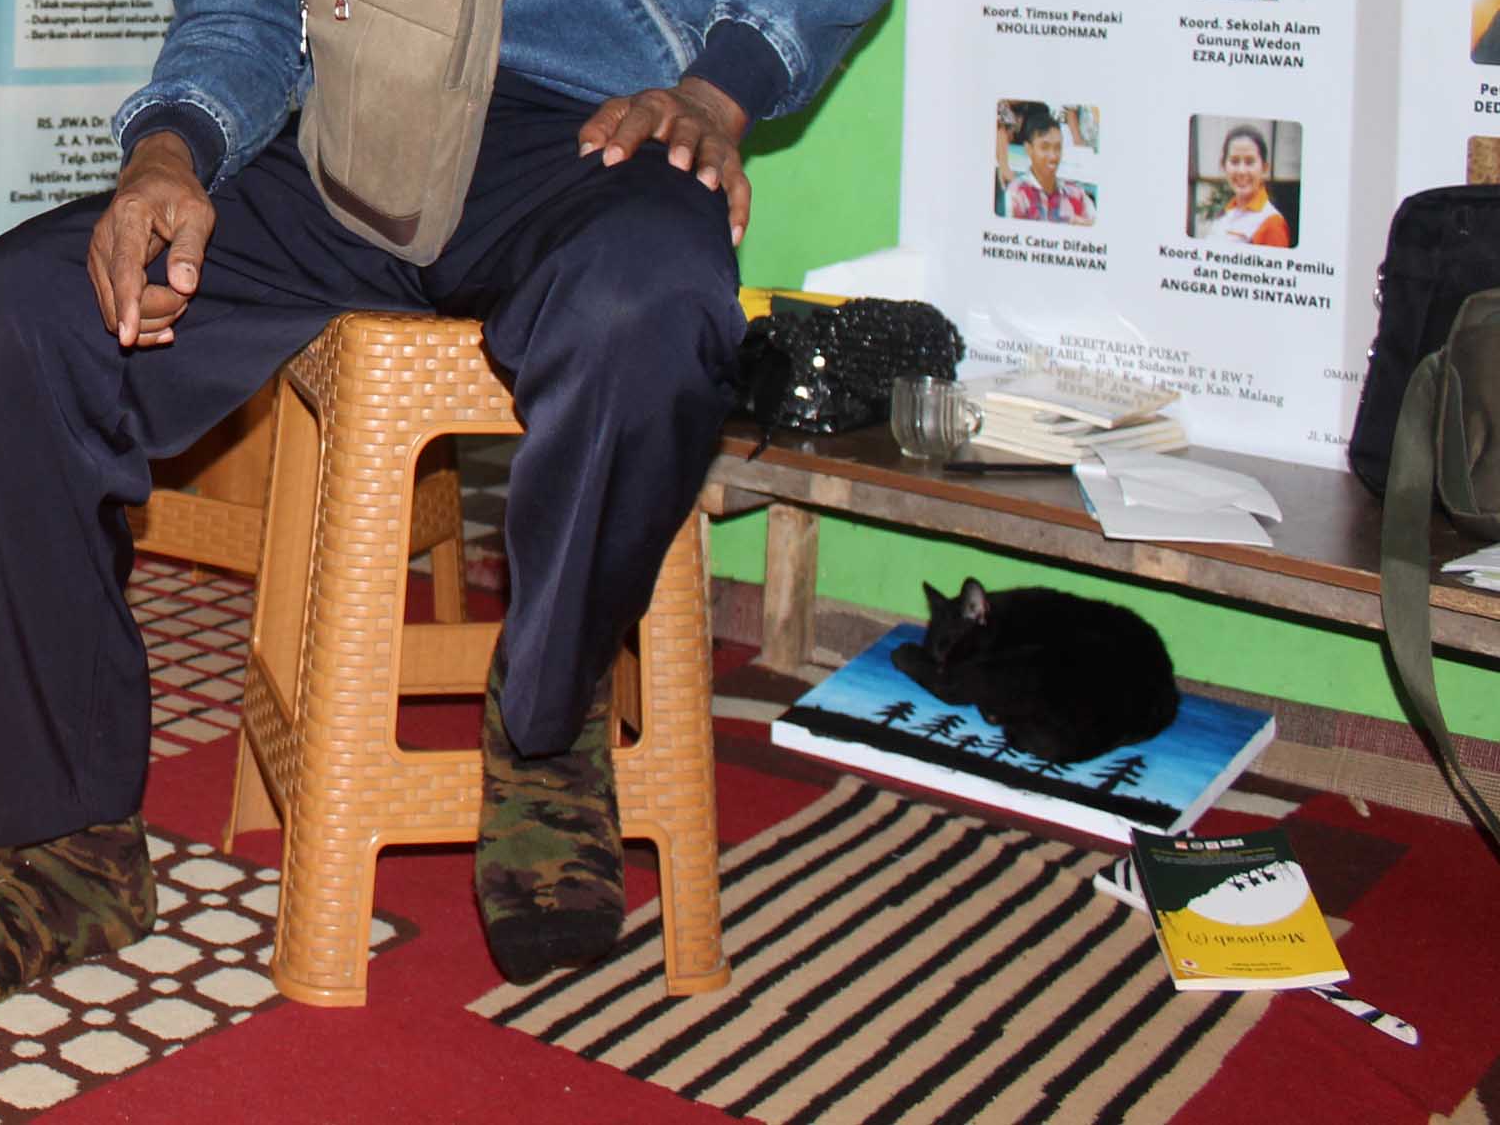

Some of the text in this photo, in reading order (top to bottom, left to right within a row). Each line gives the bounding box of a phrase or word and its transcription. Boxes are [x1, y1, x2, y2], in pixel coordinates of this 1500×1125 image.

[982, 5, 1123, 24] Koord. Timsus Pendaki
[996, 22, 1107, 40] KHOLILUROHMAN
[1179, 16, 1321, 36] Koord. Sekolah Alam
[1197, 34, 1301, 51] Gunung Wedon
[1192, 49, 1304, 68] EZRA JUNIAWAN
[1025, 236, 1058, 251] Catur
[1063, 239, 1108, 255] Difabel
[982, 246, 1107, 272] HERDIN HERMAWAN
[1159, 245, 1334, 276] Koord. Pendidikan Pemilu
[1193, 265, 1297, 289] dan Demokrasi
[1161, 277, 1331, 310] ANGGRA DWI SINTAWATI
[1188, 366, 1207, 380] RT
[1221, 369, 1243, 385] RW
[1238, 387, 1284, 407] Malang
